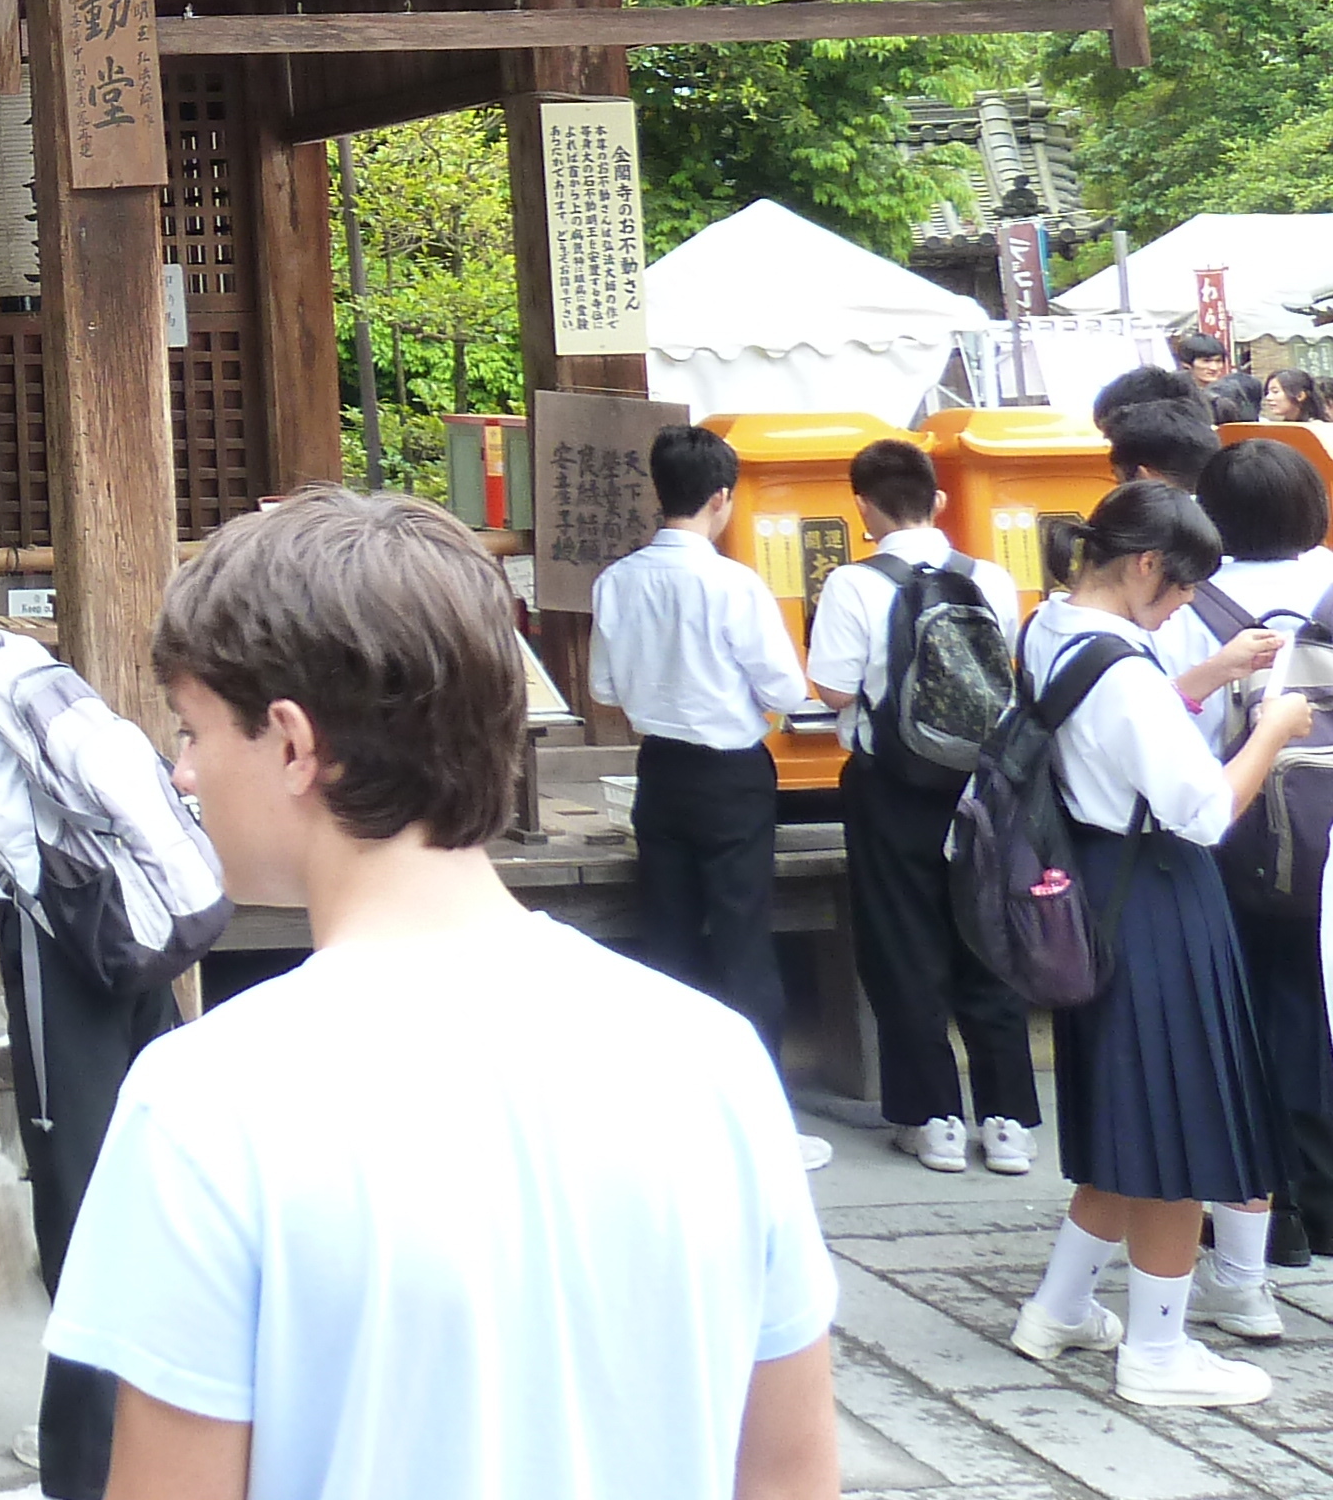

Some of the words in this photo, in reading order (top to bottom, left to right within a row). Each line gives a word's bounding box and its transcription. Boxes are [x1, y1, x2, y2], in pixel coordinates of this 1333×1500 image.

[613, 145, 640, 310] 金閣寺のお不動さん
